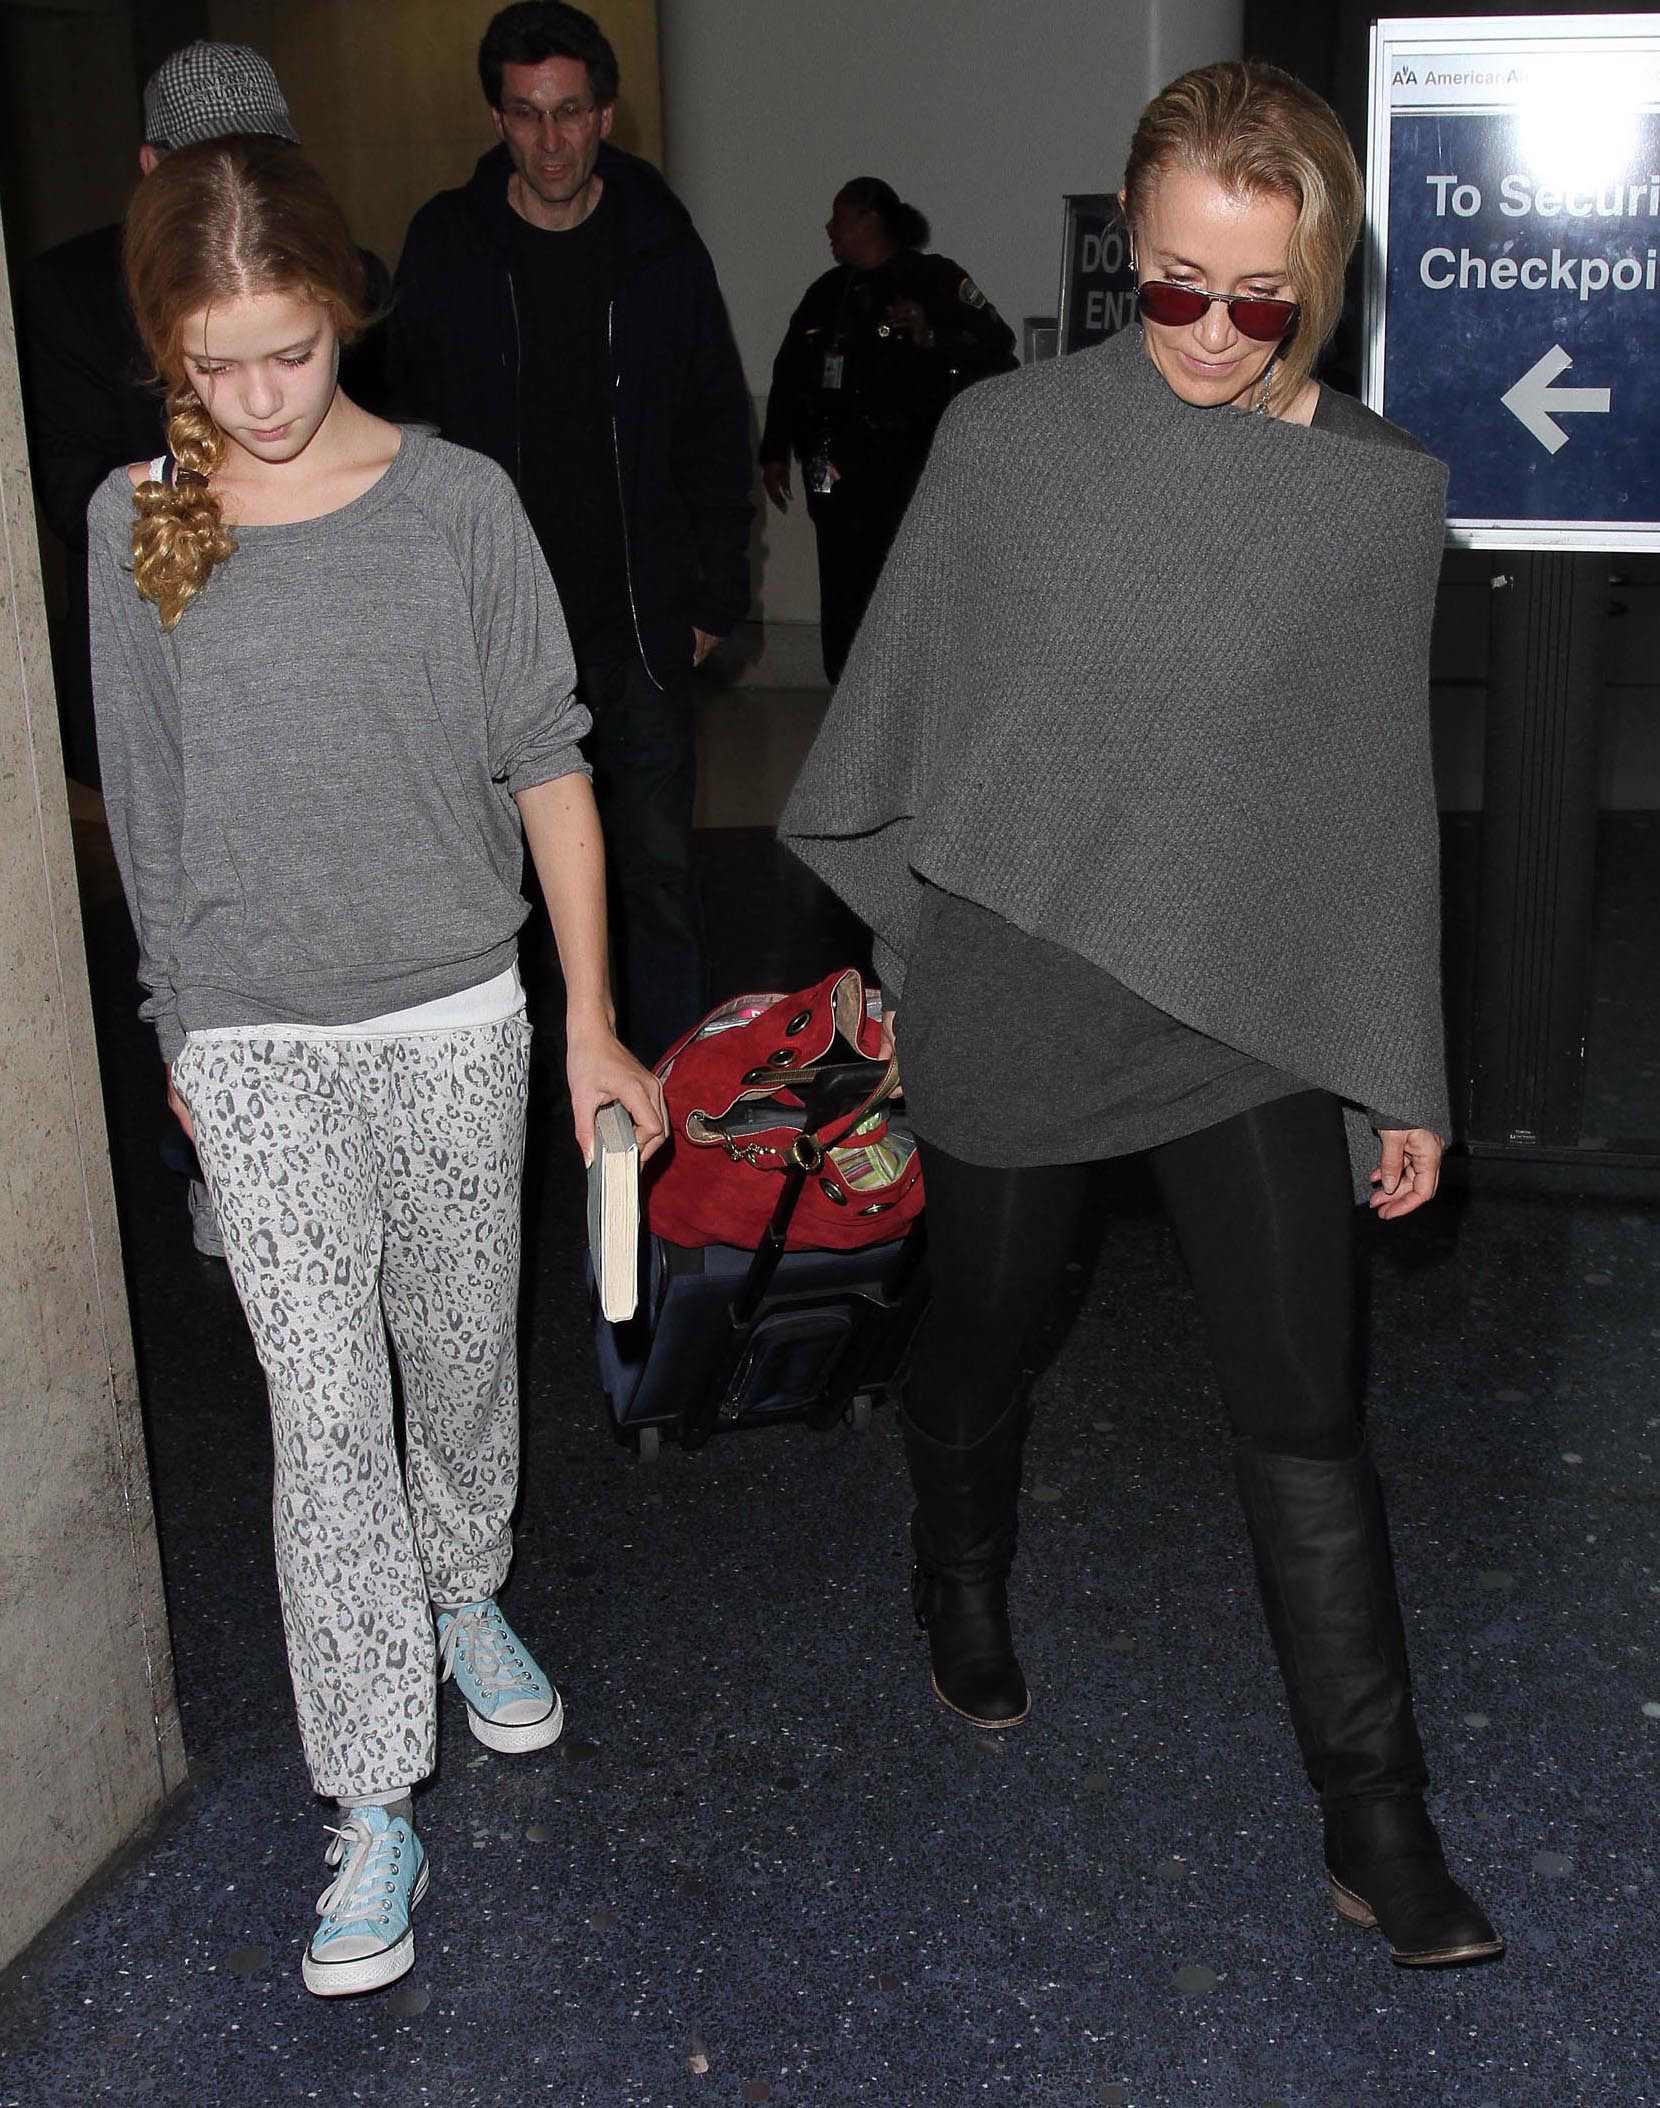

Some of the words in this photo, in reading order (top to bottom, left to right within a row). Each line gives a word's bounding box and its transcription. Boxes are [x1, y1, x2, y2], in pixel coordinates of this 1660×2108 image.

[196, 85, 261, 106] STUDIOS
[1425, 70, 1506, 86] American
[1426, 175, 1482, 217] To
[1499, 174, 1660, 218] Securi
[1082, 233, 1123, 274] DO
[1419, 247, 1657, 301] Checkpoi
